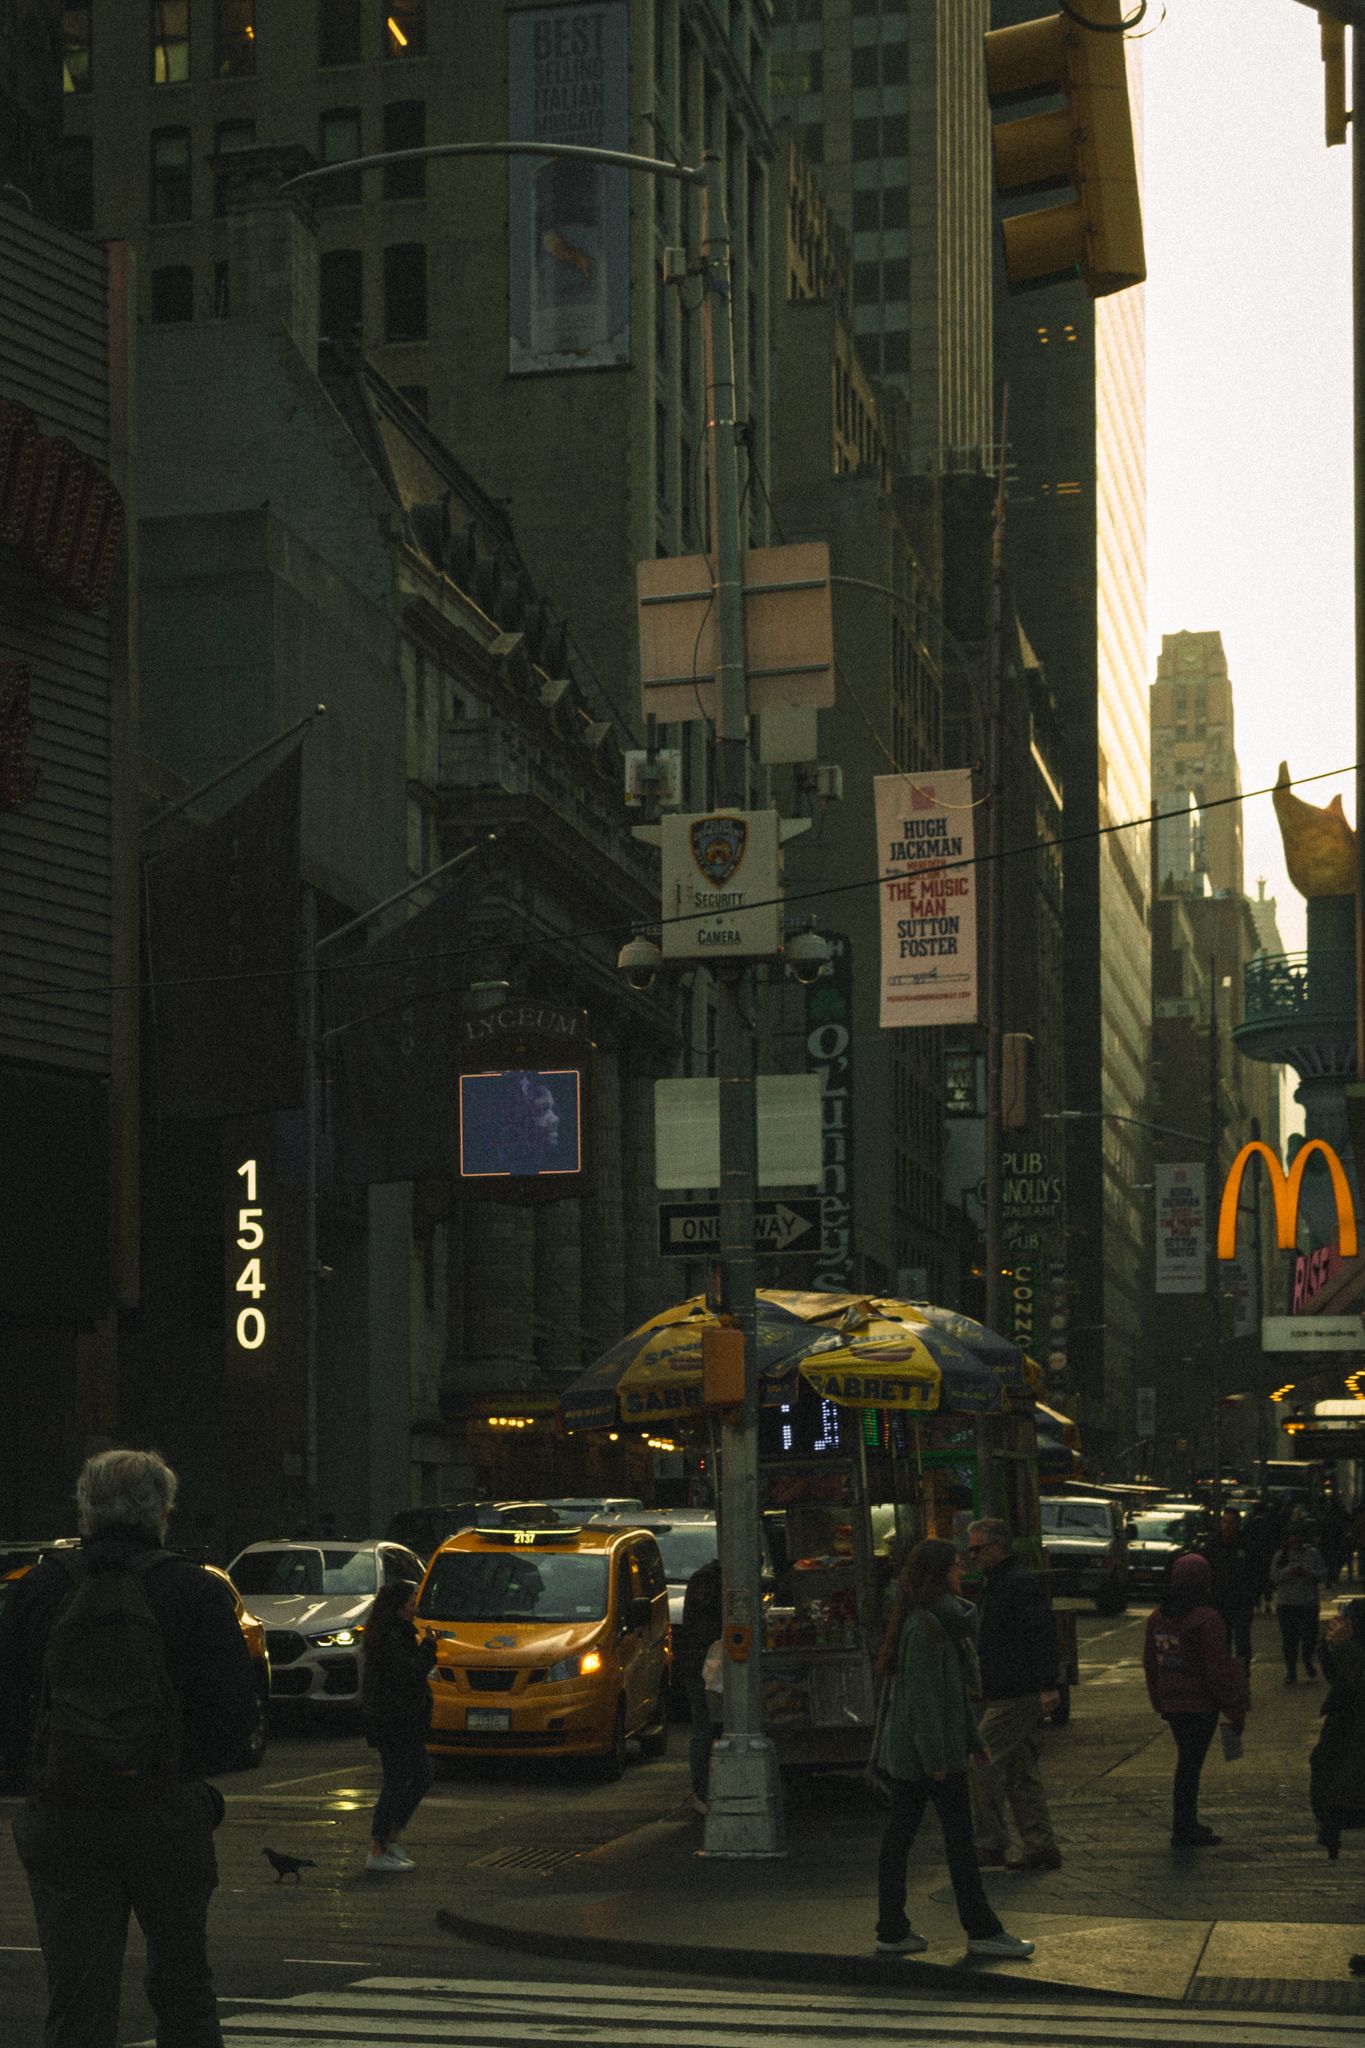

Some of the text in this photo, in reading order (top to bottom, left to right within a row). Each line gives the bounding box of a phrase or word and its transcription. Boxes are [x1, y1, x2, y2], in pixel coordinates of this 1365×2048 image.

[534, 12, 606, 60] BEST
[904, 818, 947, 840] HUGH
[890, 838, 963, 861] JACKMAN
[694, 892, 743, 907] SECURITY
[887, 877, 969, 902] THE MUSIC
[910, 899, 947, 919] MAN
[697, 929, 741, 944] CAMERA
[897, 916, 960, 939] SUTTON
[900, 936, 958, 959] FOSTER
[464, 1007, 576, 1040] LYCEUM
[1001, 1152, 1043, 1175] PUB
[235, 1159, 267, 1351] 1540
